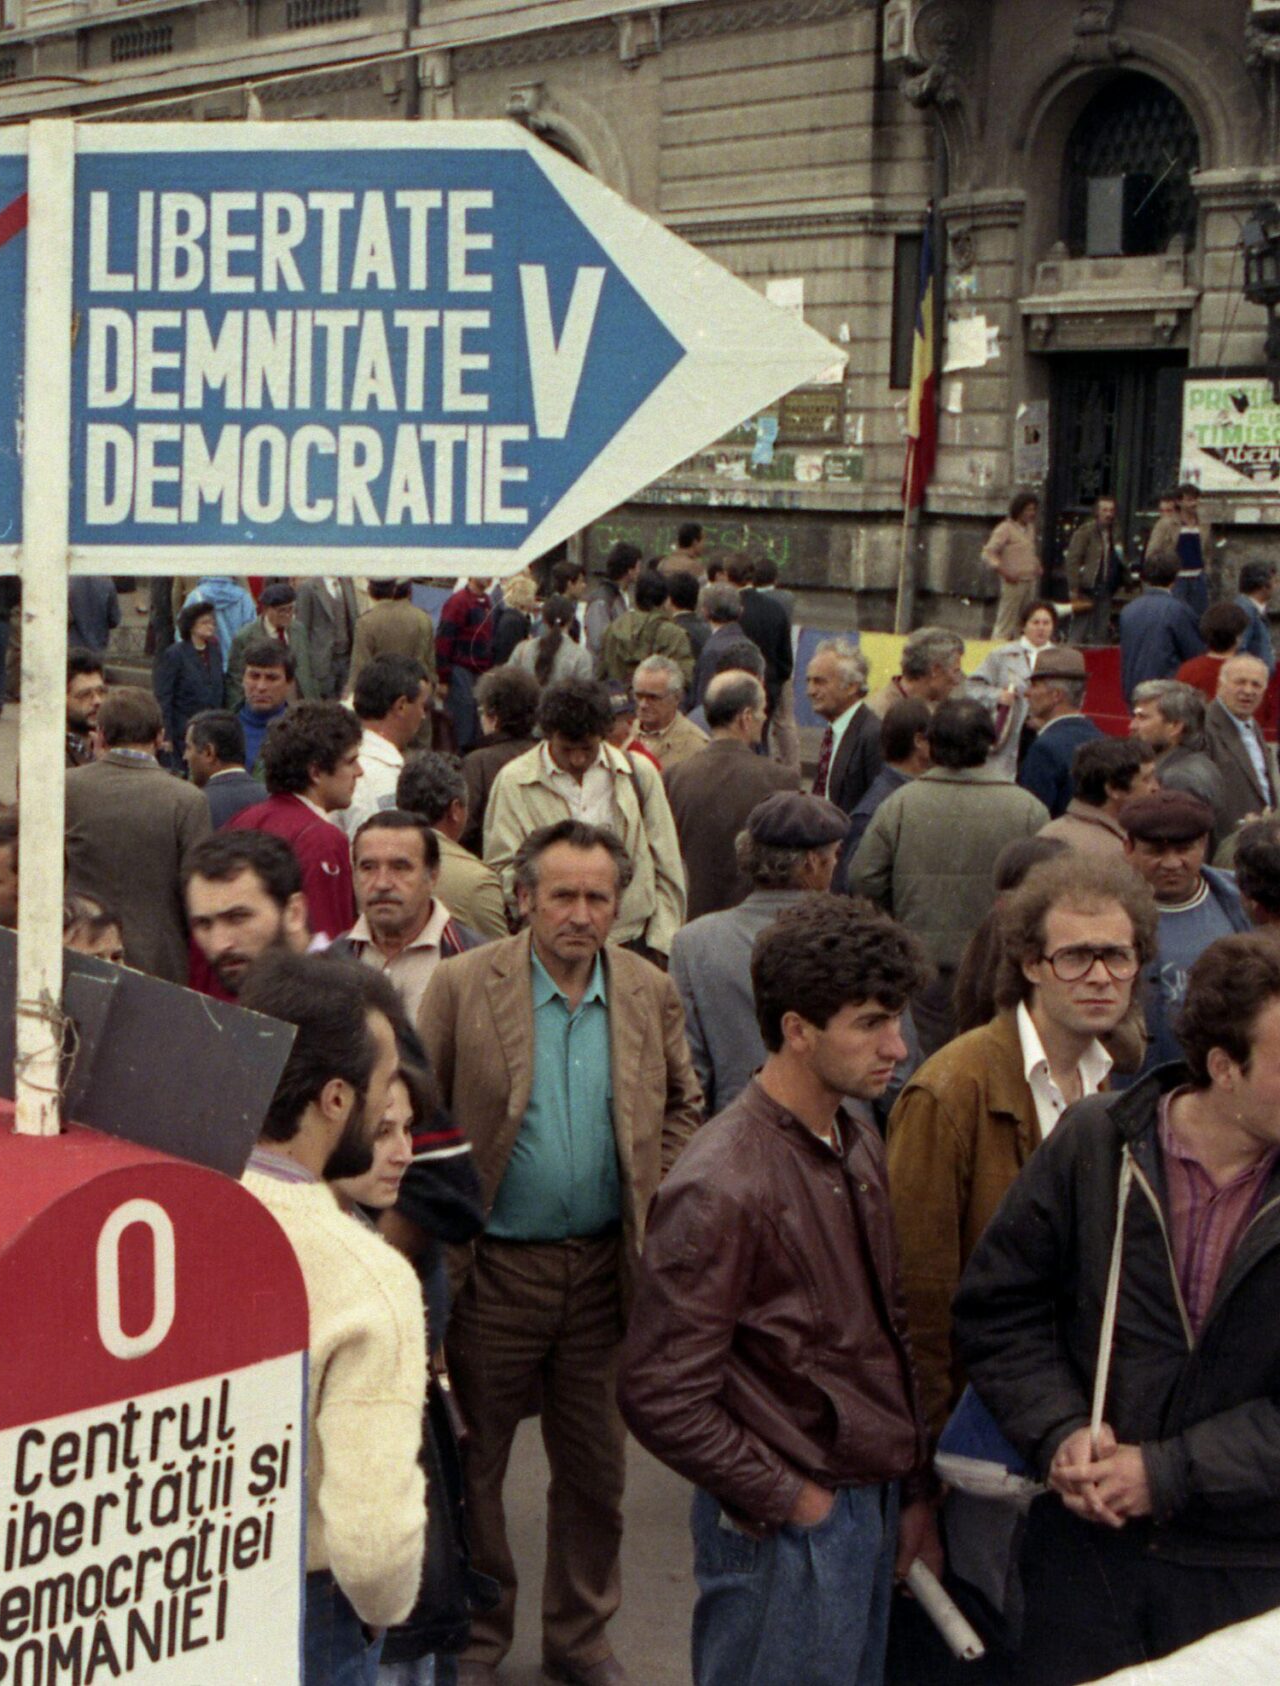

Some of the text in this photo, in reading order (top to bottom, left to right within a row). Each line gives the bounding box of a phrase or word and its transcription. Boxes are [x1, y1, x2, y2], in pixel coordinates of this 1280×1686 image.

[88, 190, 494, 294] LIBERTATE
[87, 308, 491, 412] DEMNITATE
[518, 264, 607, 440] V
[85, 423, 530, 527] DEMOCRATIE
[15, 1379, 235, 1497] Centrul
